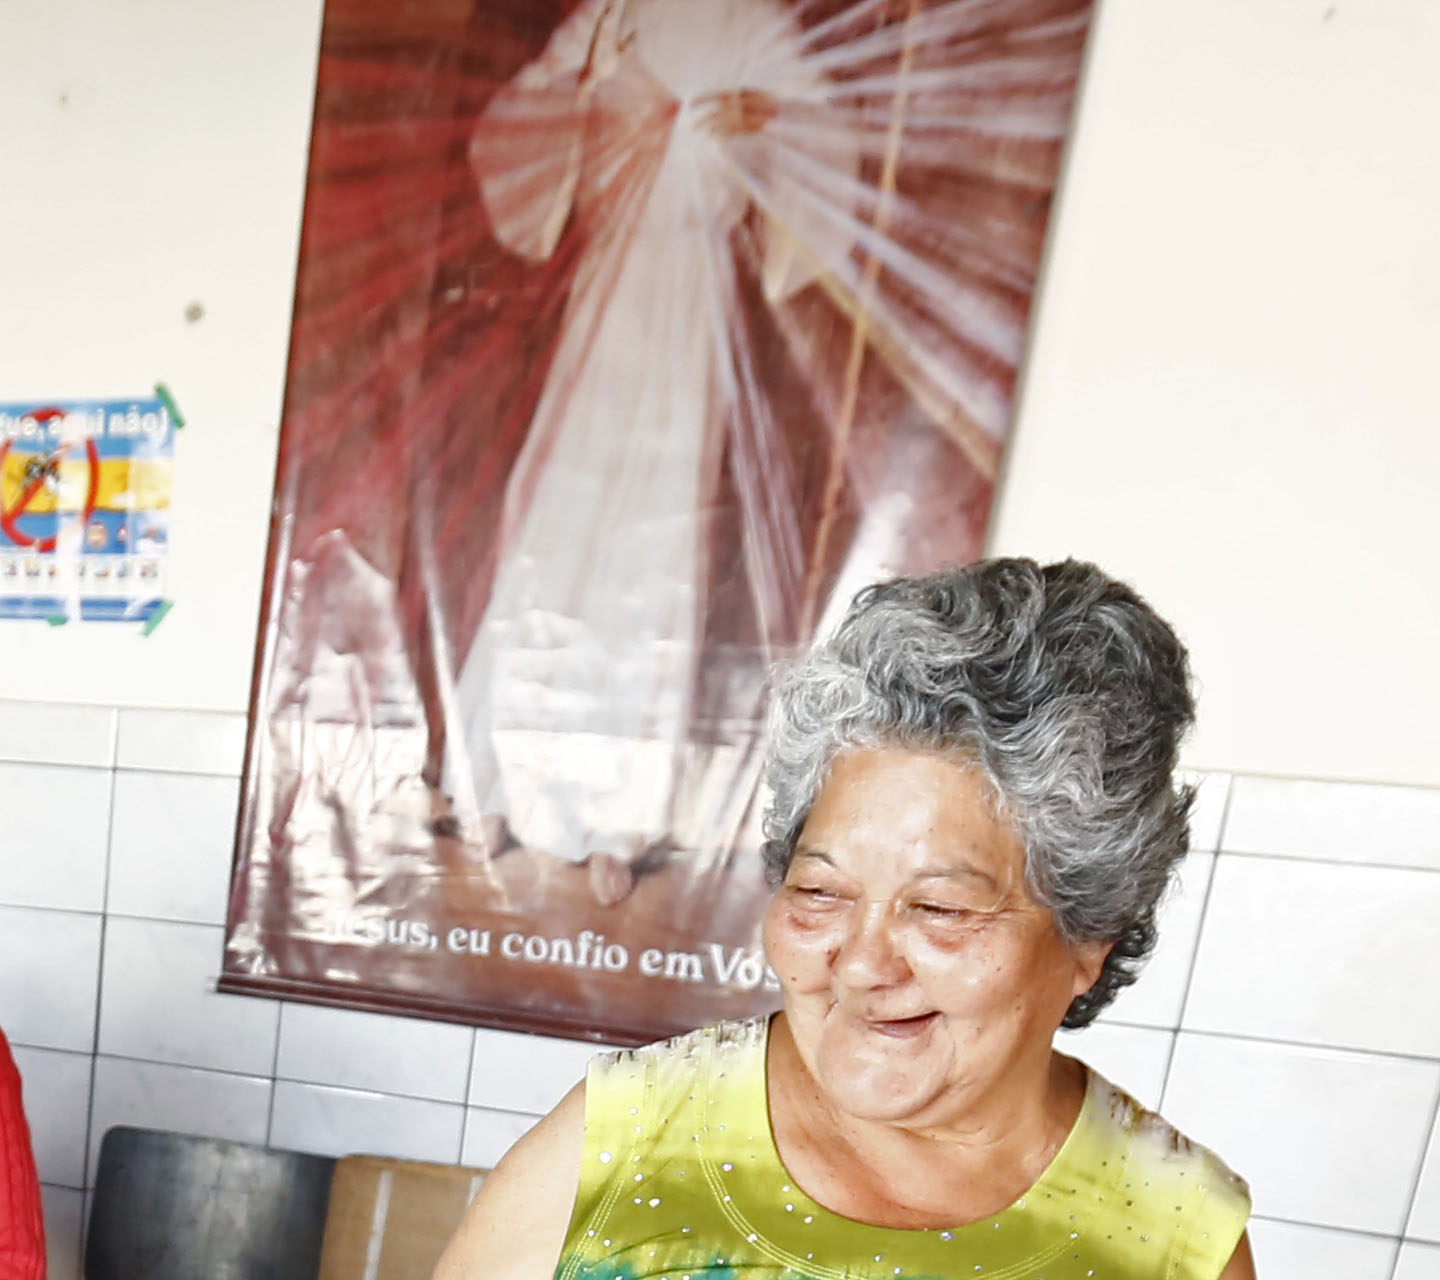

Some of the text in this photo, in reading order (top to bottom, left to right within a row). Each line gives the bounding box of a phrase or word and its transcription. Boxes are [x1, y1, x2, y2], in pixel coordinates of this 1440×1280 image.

[446, 926, 491, 956] eu
[501, 929, 629, 970] confio
[639, 950, 704, 982] em
